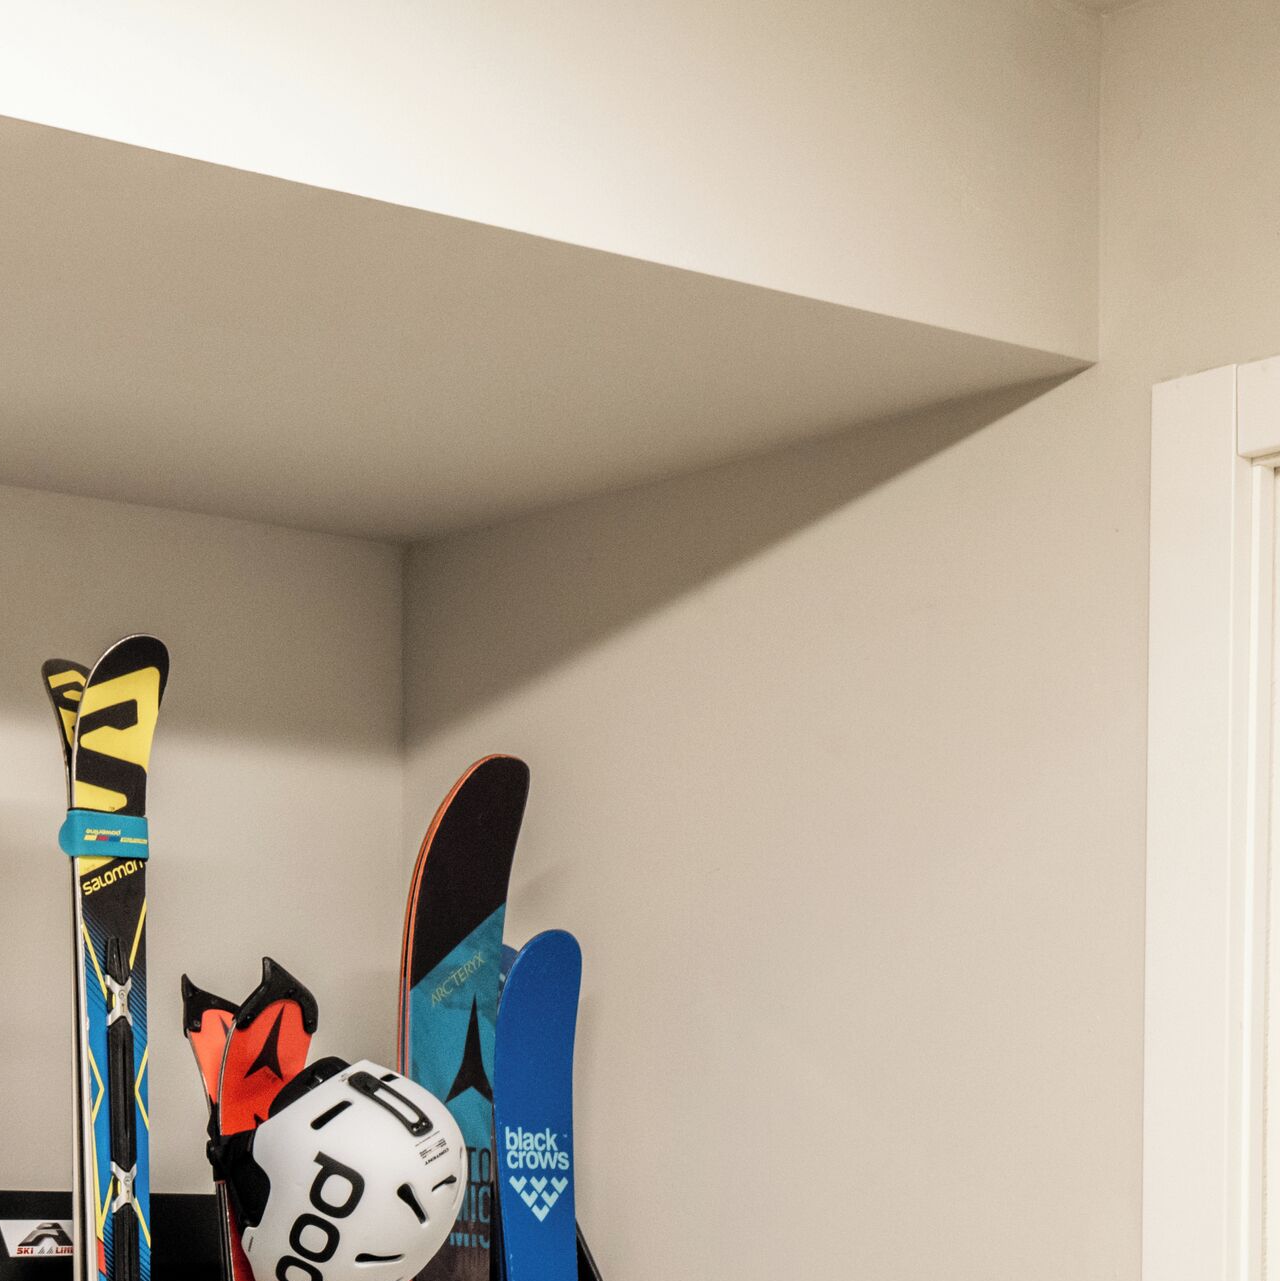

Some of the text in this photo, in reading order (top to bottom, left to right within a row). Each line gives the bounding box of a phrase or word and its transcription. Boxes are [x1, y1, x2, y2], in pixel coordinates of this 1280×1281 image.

[505, 1126, 559, 1151] black
[506, 1150, 570, 1170] crows
[16, 1247, 34, 1255] SKI
